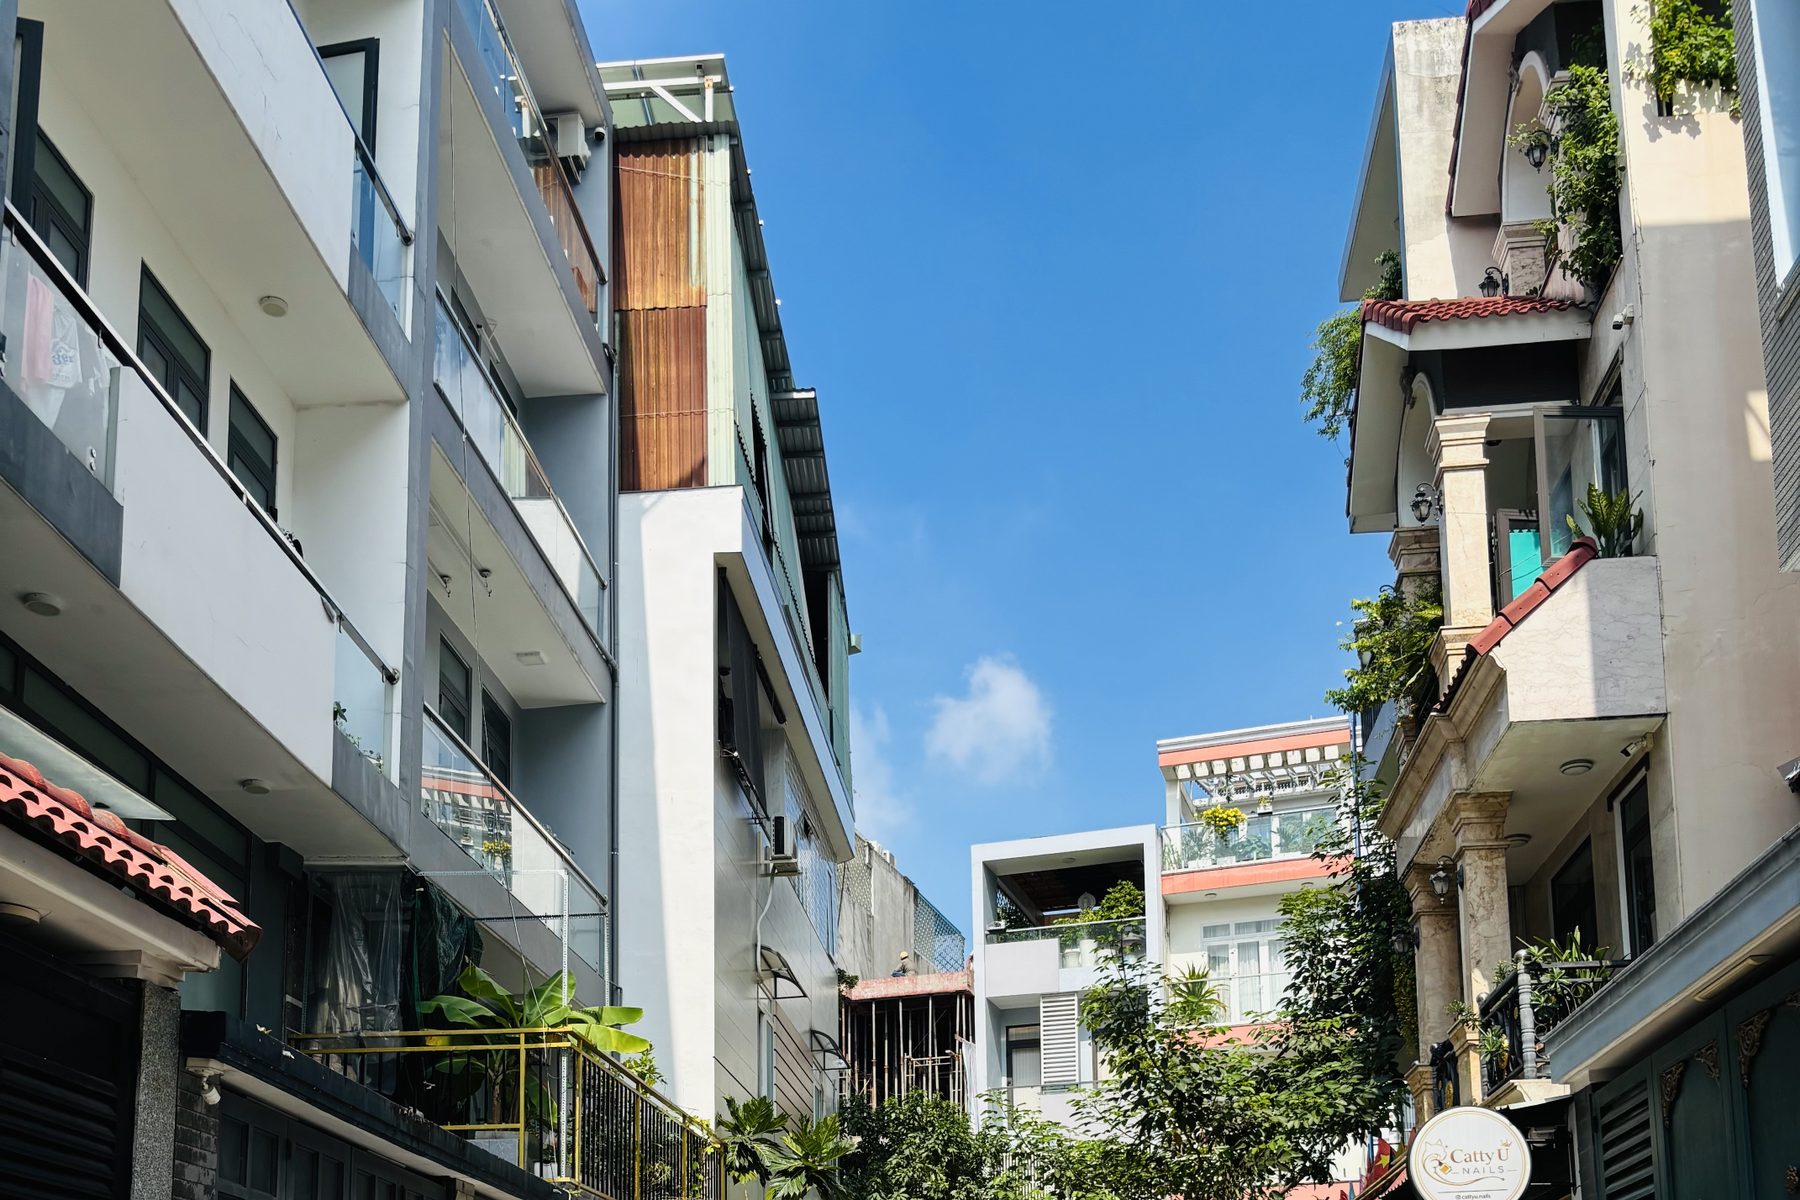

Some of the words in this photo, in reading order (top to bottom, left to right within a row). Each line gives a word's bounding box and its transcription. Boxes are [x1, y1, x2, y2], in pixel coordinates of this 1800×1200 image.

[1450, 1148, 1495, 1165] Catty
[1497, 1148, 1509, 1161] U
[1462, 1165, 1505, 1175] NAILS
